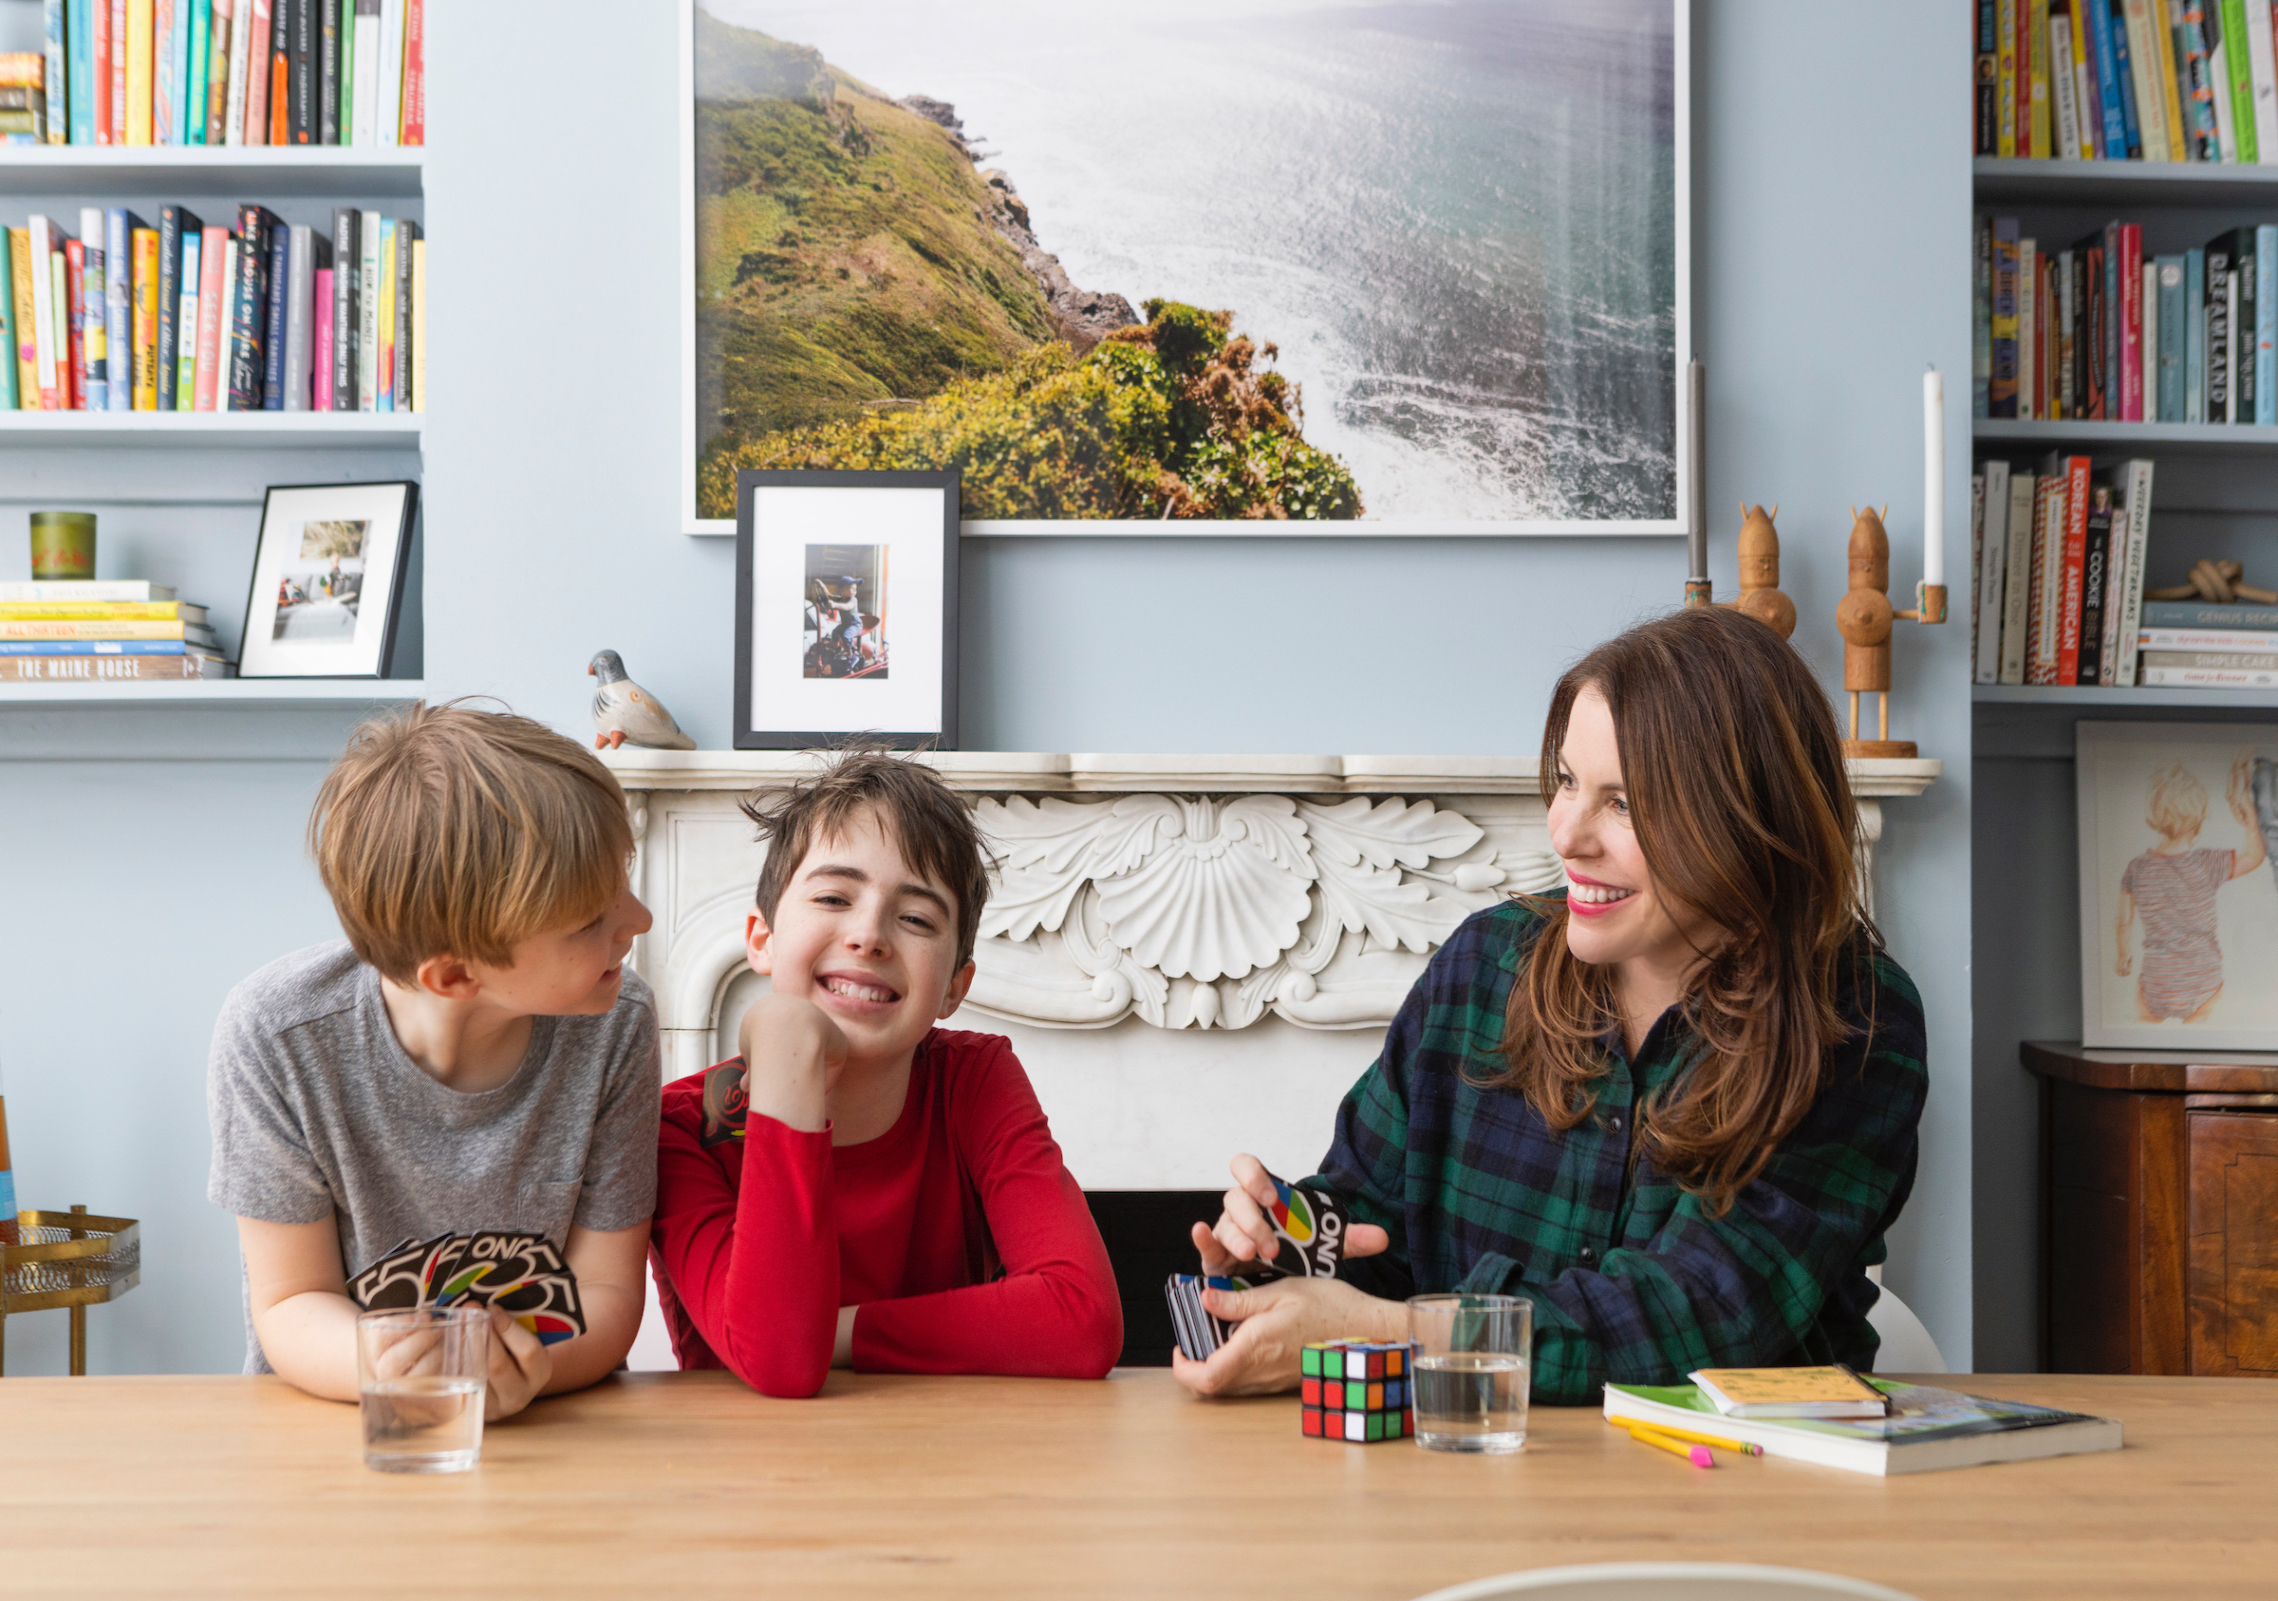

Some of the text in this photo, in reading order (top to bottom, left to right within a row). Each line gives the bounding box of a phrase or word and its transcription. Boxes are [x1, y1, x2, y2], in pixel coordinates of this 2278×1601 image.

[245, 210, 257, 240] LIKE
[162, 219, 174, 275] Elizabeth
[242, 257, 256, 300] HOUSE
[271, 254, 283, 304] THOUSAND
[202, 290, 218, 334] SEEK
[242, 303, 254, 325] ON
[269, 304, 282, 336] SMALL
[337, 261, 349, 387] IMAGINE WANTING ONLY THIS
[363, 310, 374, 347] MONEY
[2207, 253, 2229, 404] DREAMLAND
[201, 340, 216, 373] YOU
[239, 328, 252, 358] FIRE
[267, 338, 280, 383] SANITIES
[2069, 466, 2086, 534] KOREAN
[2131, 479, 2146, 536] WEEKDAY
[2012, 531, 2026, 577] Dinner
[2087, 550, 2104, 608] COOKIE
[2125, 539, 2142, 621] VEGETARIANS
[2009, 598, 2022, 626] One
[2063, 564, 2080, 651] AMERICAN
[2196, 611, 2242, 624] GENIUS
[6, 624, 25, 636] ALL
[27, 624, 76, 637] THIRTEEN
[2083, 609, 2099, 651] BIBLE
[17, 659, 140, 678] THE MAINE HOUSE
[2194, 654, 2275, 669] SIMPLE CAKE
[1315, 1211, 1342, 1278] UNO
